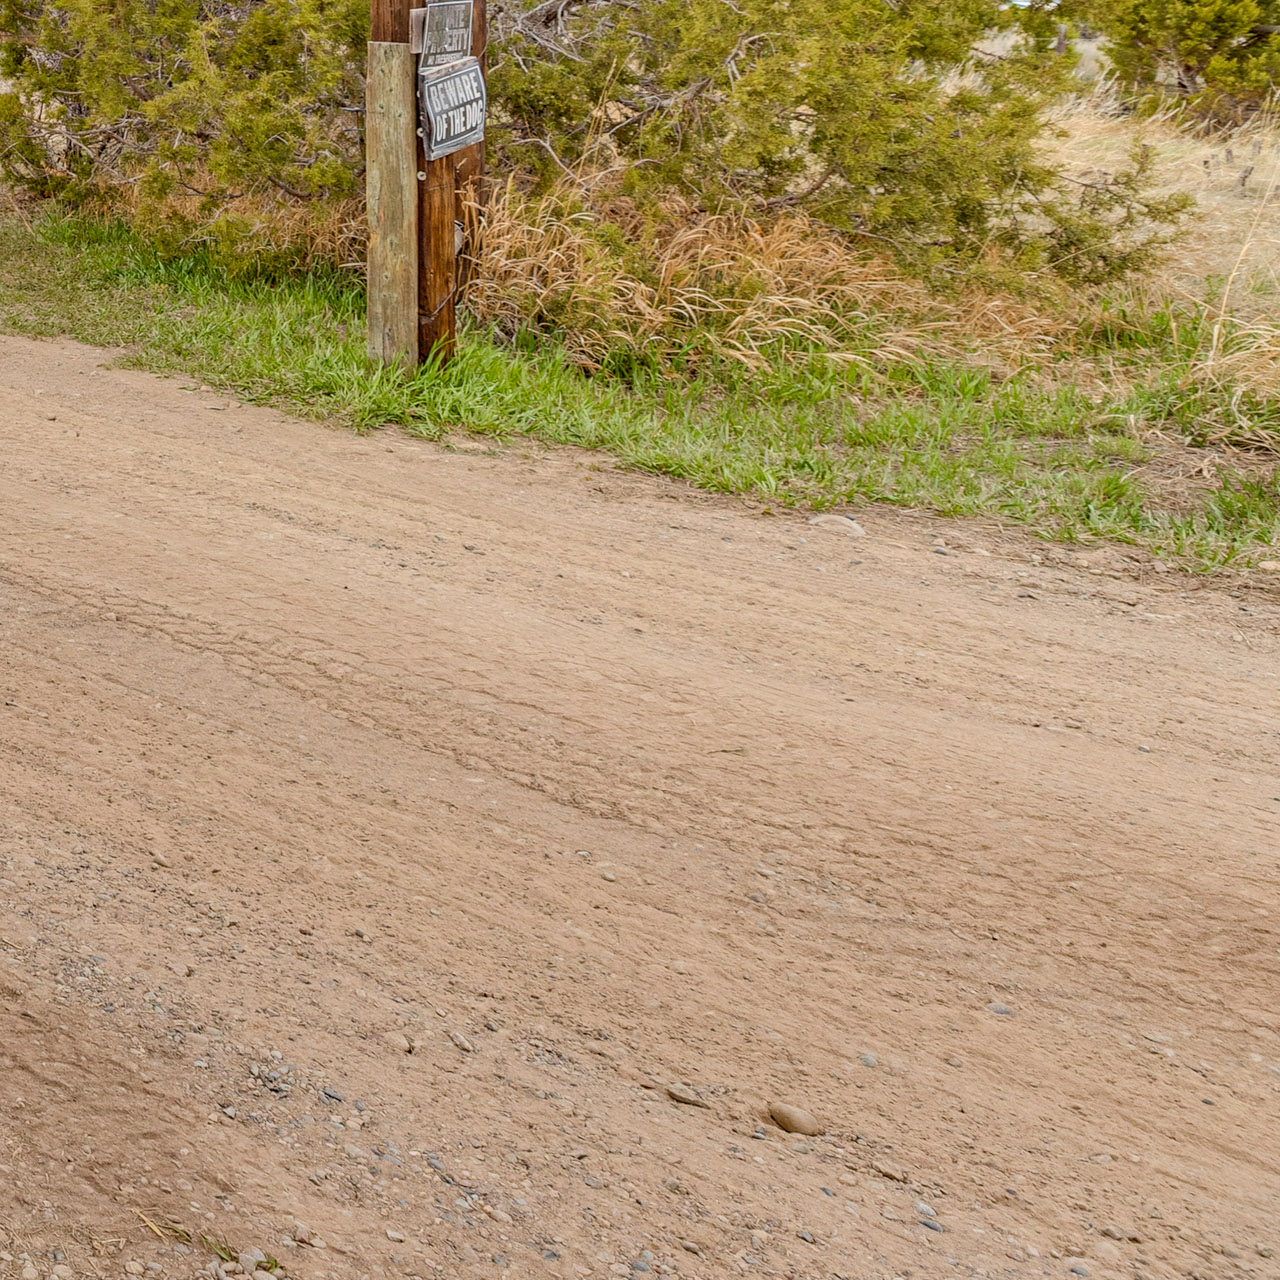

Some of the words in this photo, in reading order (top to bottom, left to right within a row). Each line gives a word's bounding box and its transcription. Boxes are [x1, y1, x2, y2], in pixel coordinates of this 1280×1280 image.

[429, 71, 481, 113] BEWARE
[436, 113, 448, 142] OF
[448, 106, 466, 137] THE
[466, 99, 483, 130] DOG
